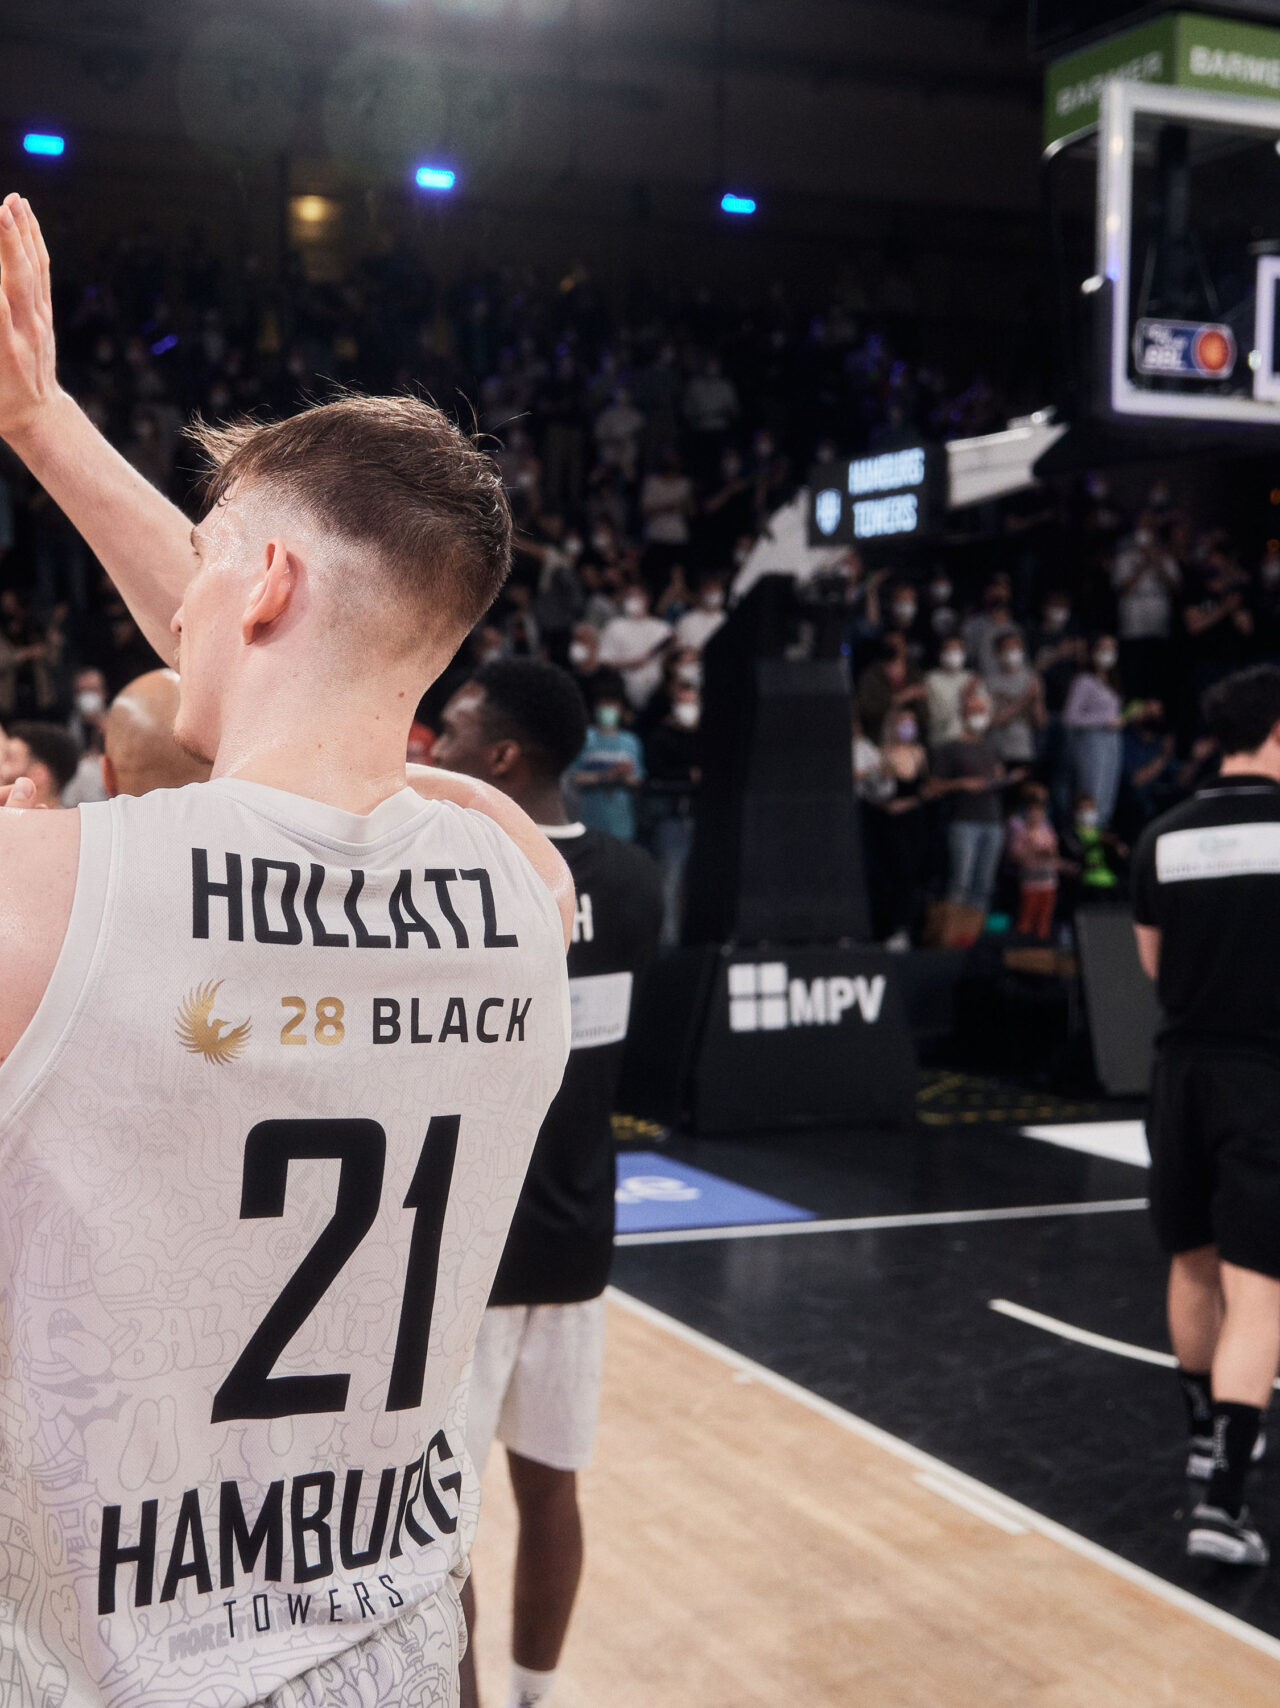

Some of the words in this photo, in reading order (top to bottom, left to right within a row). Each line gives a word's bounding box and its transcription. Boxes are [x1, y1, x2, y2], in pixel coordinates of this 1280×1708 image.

[191, 848, 518, 949] HOLLATZ
[280, 996, 345, 1046] 28
[372, 996, 533, 1045] BLACK
[788, 974, 886, 1026] MPV
[210, 1114, 461, 1424] 21
[97, 1430, 464, 1616] HAMBURG
[223, 1574, 404, 1638] TOWERS
